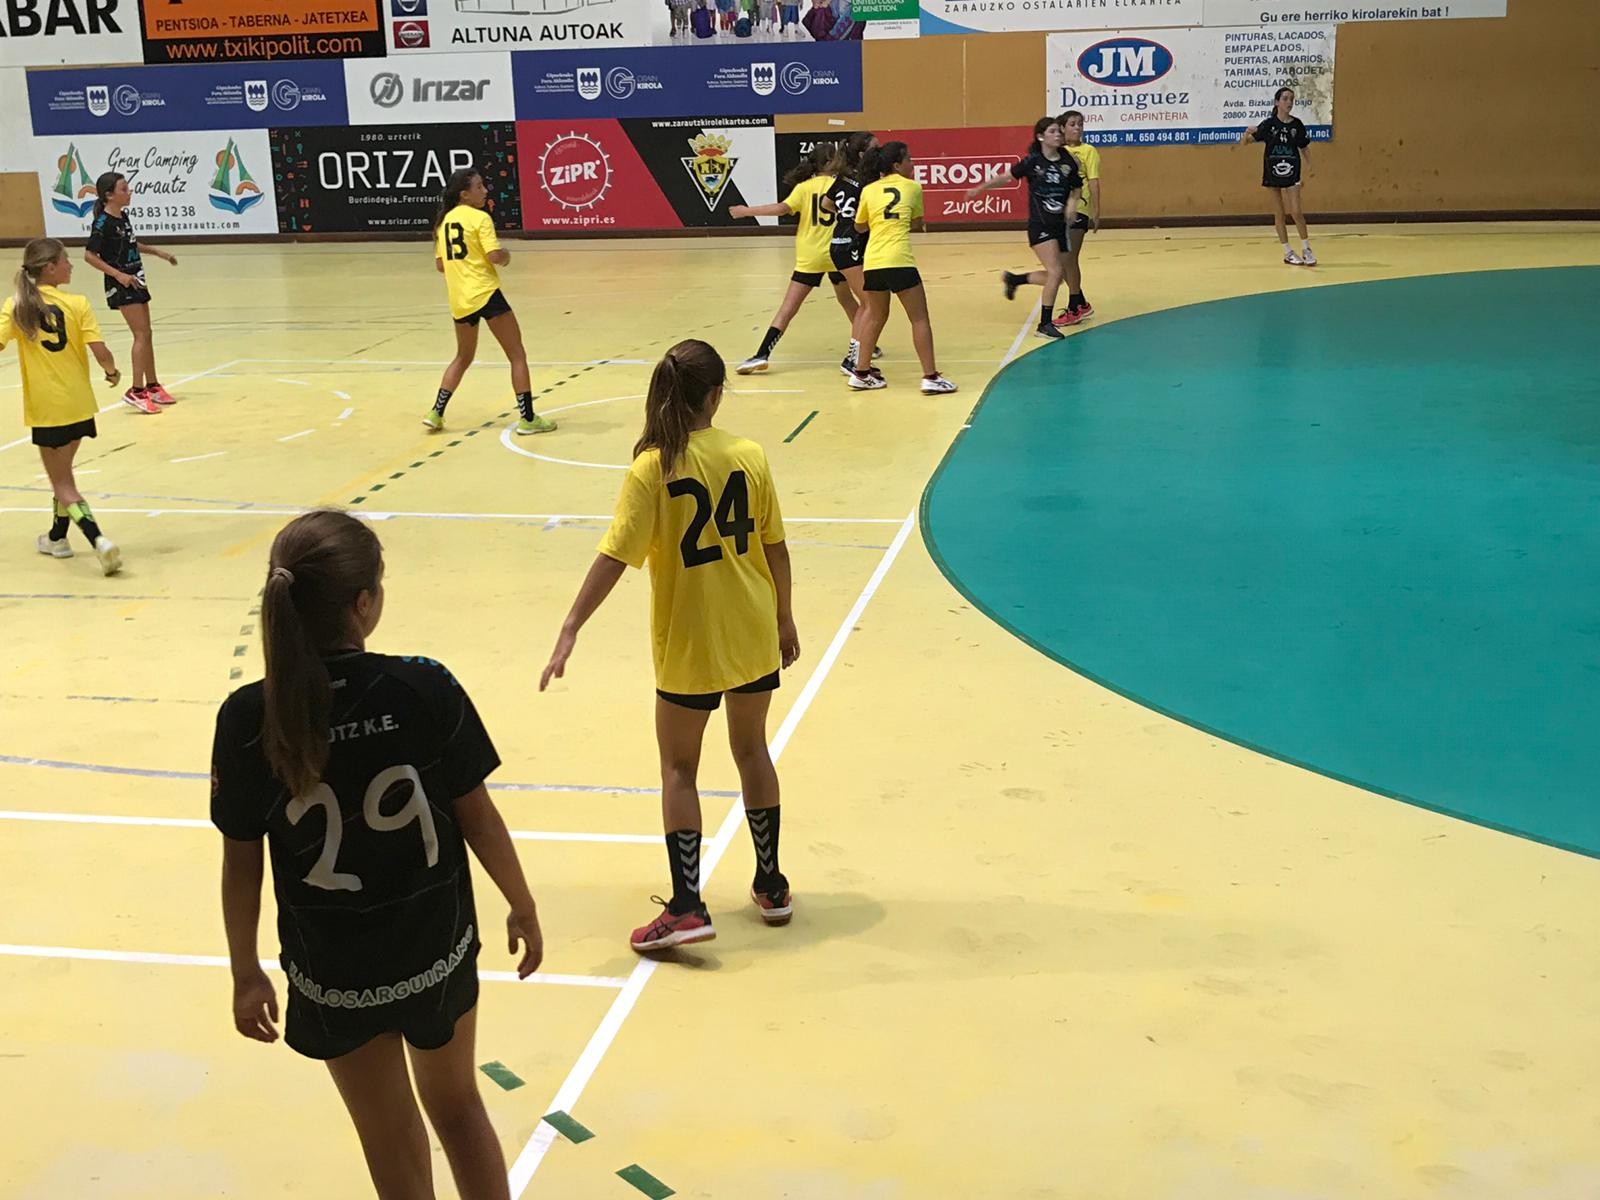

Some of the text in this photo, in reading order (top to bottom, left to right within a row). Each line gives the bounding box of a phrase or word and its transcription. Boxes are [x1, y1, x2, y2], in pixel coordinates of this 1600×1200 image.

[945, 2, 1015, 13] ZARAUZKO
[1023, 0, 1107, 10] OSTALARIEN
[1260, 12, 1278, 23] Gu
[1281, 12, 1301, 22] ere
[1304, 10, 1348, 21] herriko
[1352, 8, 1418, 20] kirolarekin
[1421, 7, 1442, 17] bat
[156, 18, 219, 31] PENTSIOA
[229, 14, 291, 28] TABERNA
[302, 10, 368, 25] JATETXEA
[451, 22, 624, 44] ALTUNA AUTOAK
[166, 36, 363, 59] www.txikipolit.com
[1088, 46, 1156, 78] JM
[413, 78, 491, 103] Irizar
[1061, 87, 1189, 110] Dominguez
[1248, 99, 1276, 107] Bizkai
[1083, 112, 1189, 123] URA CARPINTERIA
[1248, 110, 1273, 119] ZARA
[1085, 133, 1100, 143] 130
[1102, 133, 1117, 143] 336
[1139, 132, 1155, 142] 650
[1157, 132, 1172, 141] 494
[1174, 131, 1190, 141] 881
[107, 146, 199, 174] Gran Camping
[147, 206, 161, 217] 83
[165, 206, 179, 217] 12
[181, 205, 196, 217] 38
[835, 191, 856, 218] 26
[883, 187, 901, 220] 2
[943, 195, 1011, 215] zurekin
[368, 218, 429, 226] www.orizar.com
[542, 215, 616, 226] www.zipri.es
[445, 222, 468, 261] 13
[39, 304, 67, 352] 9
[666, 470, 755, 569] 24
[364, 714, 399, 736] K.E.
[286, 763, 439, 892] 29
